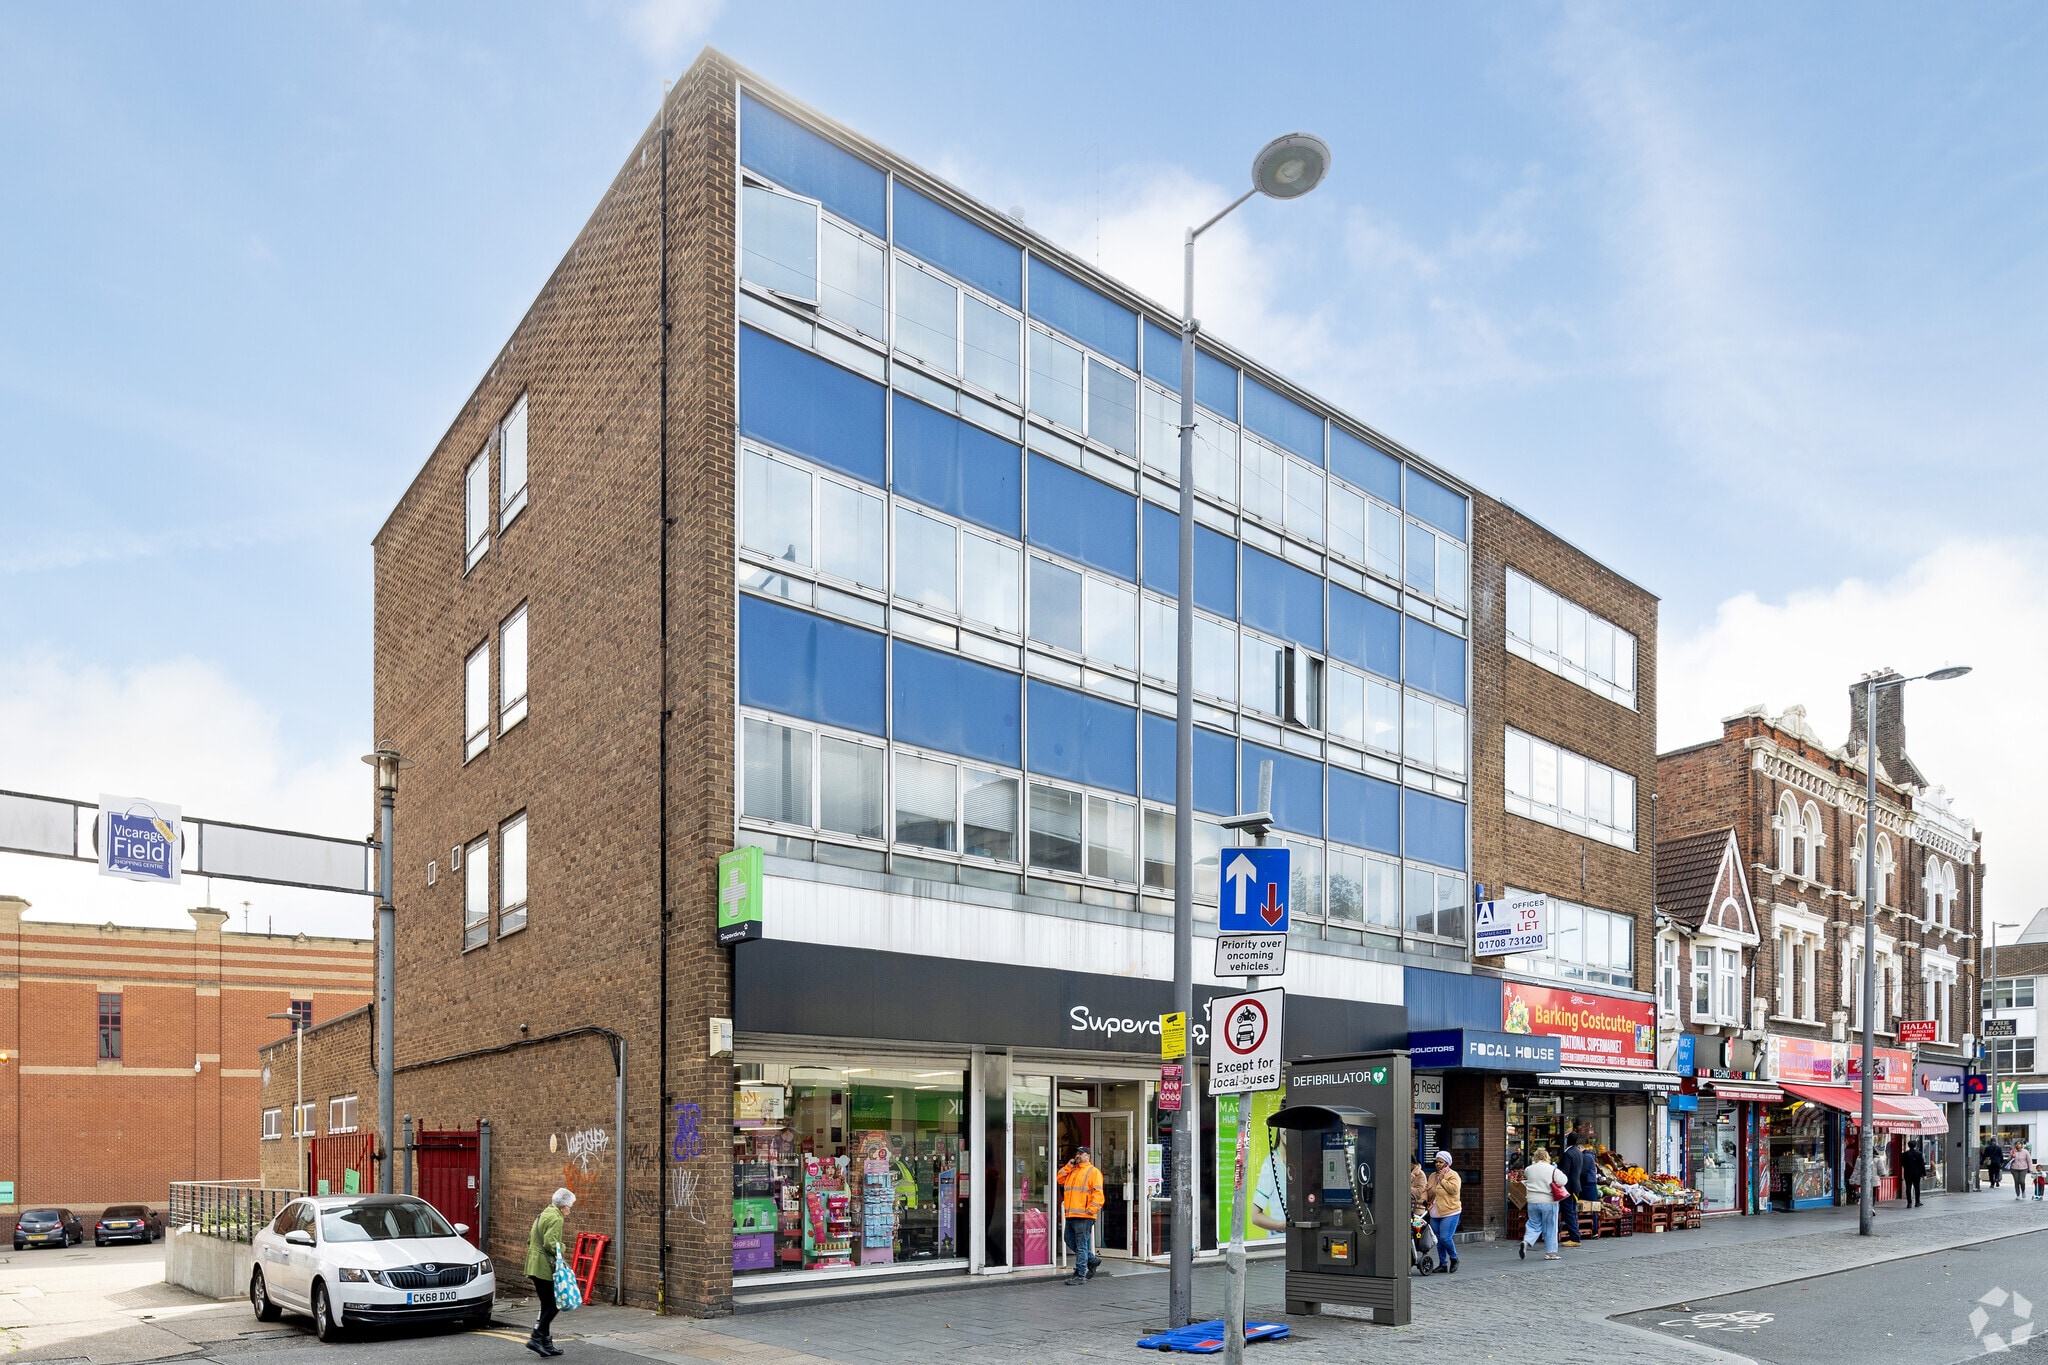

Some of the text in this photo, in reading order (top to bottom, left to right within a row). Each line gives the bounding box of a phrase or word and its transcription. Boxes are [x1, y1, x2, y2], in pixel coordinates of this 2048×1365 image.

[114, 824, 164, 843] Vicarage
[114, 837, 164, 861] Field
[114, 859, 141, 867] SHOPPING
[1512, 900, 1544, 909] OFFICES
[1520, 909, 1536, 919] TO
[1517, 921, 1540, 932] LET
[720, 930, 746, 941] Superdrug
[1477, 929, 1510, 938] COMMERCIAL
[1221, 940, 1282, 950] Priority over
[1479, 935, 1543, 949] 01708 731200
[1227, 951, 1274, 960] oncoming
[1230, 962, 1269, 971] vehicles
[1535, 1005, 1637, 1034] Barking Costcutter
[1902, 1022, 1935, 1030] HALAL
[1680, 1038, 1691, 1048] WIDE
[1410, 1045, 1455, 1053] SOLICITORS
[1470, 1042, 1555, 1060] FOCAL HOUSE
[1217, 1058, 1274, 1074] Except for
[1678, 1065, 1690, 1075] CARE
[1213, 1073, 1275, 1088] local buses
[1293, 1071, 1371, 1087] DEFIBRILLATOR
[1422, 1080, 1440, 1094] Reed
[1930, 1077, 1960, 1093] nationwide
[1222, 1115, 1236, 1123] HUB
[413, 1291, 457, 1303] CK68 DXO
